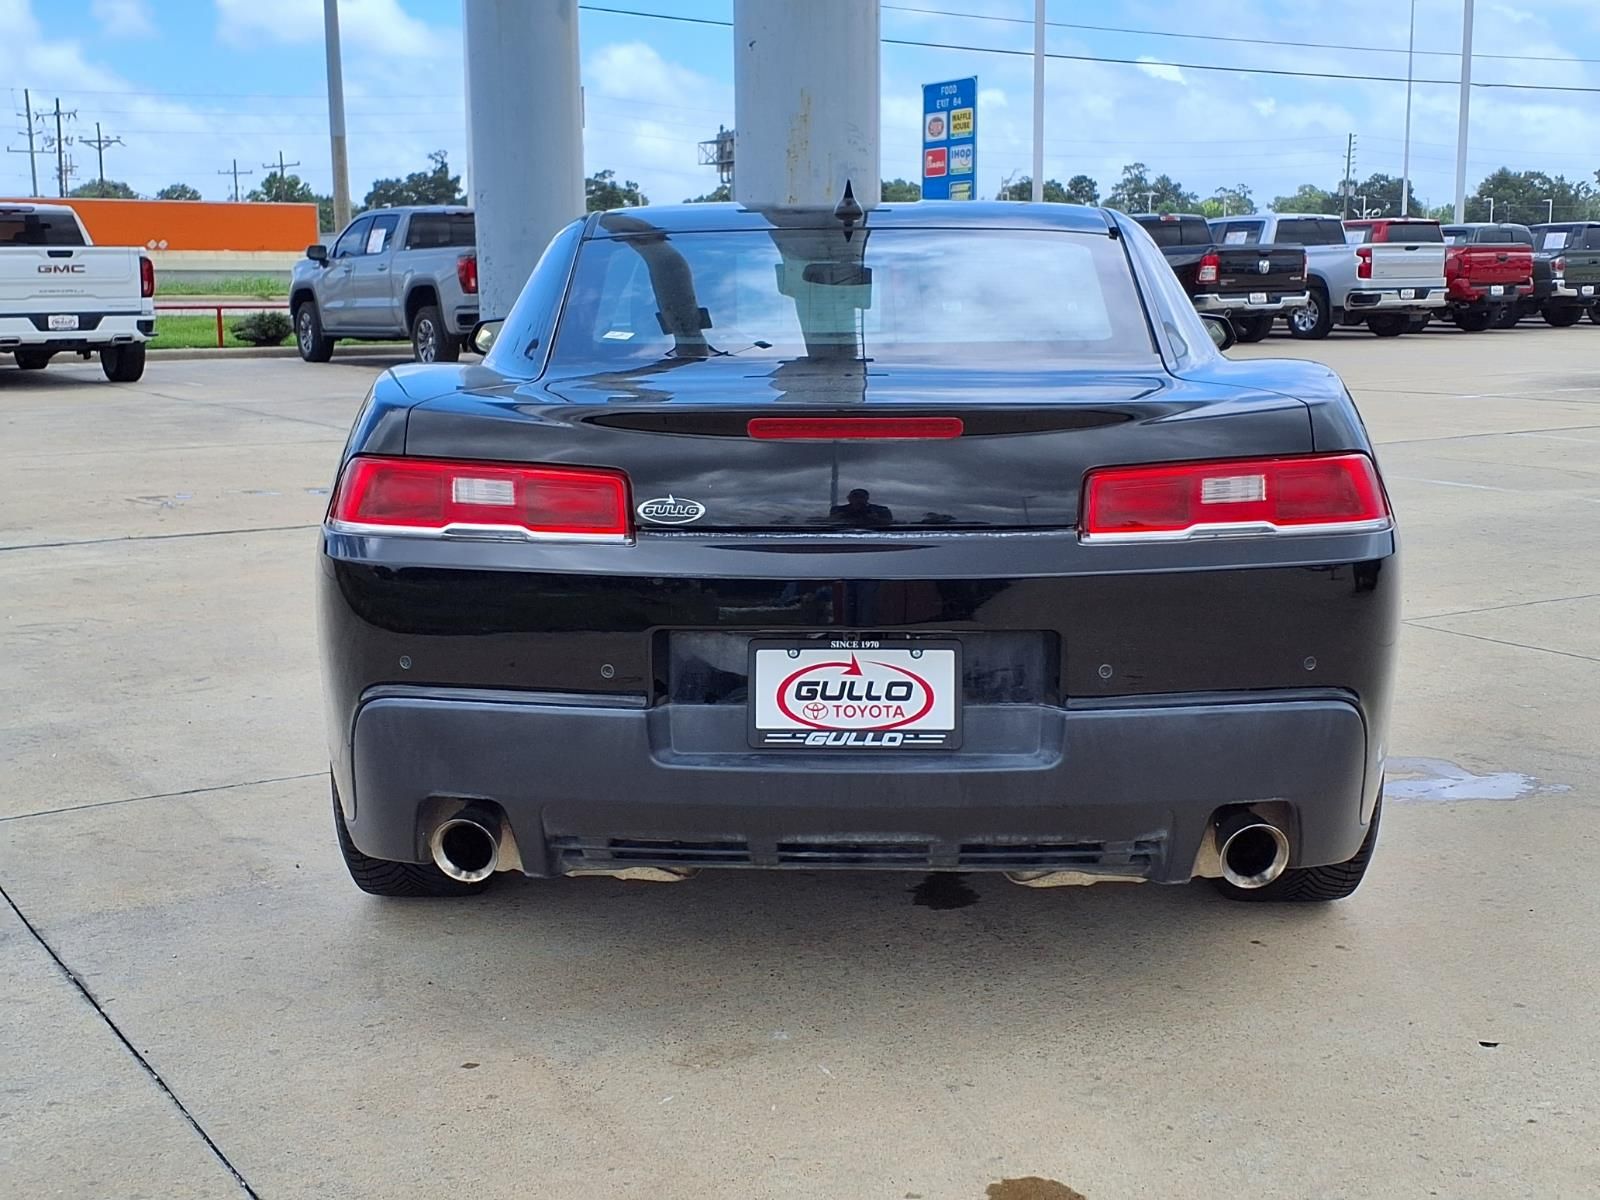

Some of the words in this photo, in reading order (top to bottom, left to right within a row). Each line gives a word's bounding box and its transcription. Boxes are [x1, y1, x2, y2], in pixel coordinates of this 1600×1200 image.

[940, 84, 957, 96] FOOD
[936, 99, 949, 109] EXIT
[951, 148, 971, 160] IHOP
[38, 264, 86, 273] GMC
[642, 505, 700, 516] GULLO
[830, 640, 859, 649] SINCE
[861, 640, 880, 649] 1970
[794, 680, 914, 702] GULLO
[832, 704, 906, 719] TOYOTA
[804, 731, 904, 746] GULLO
